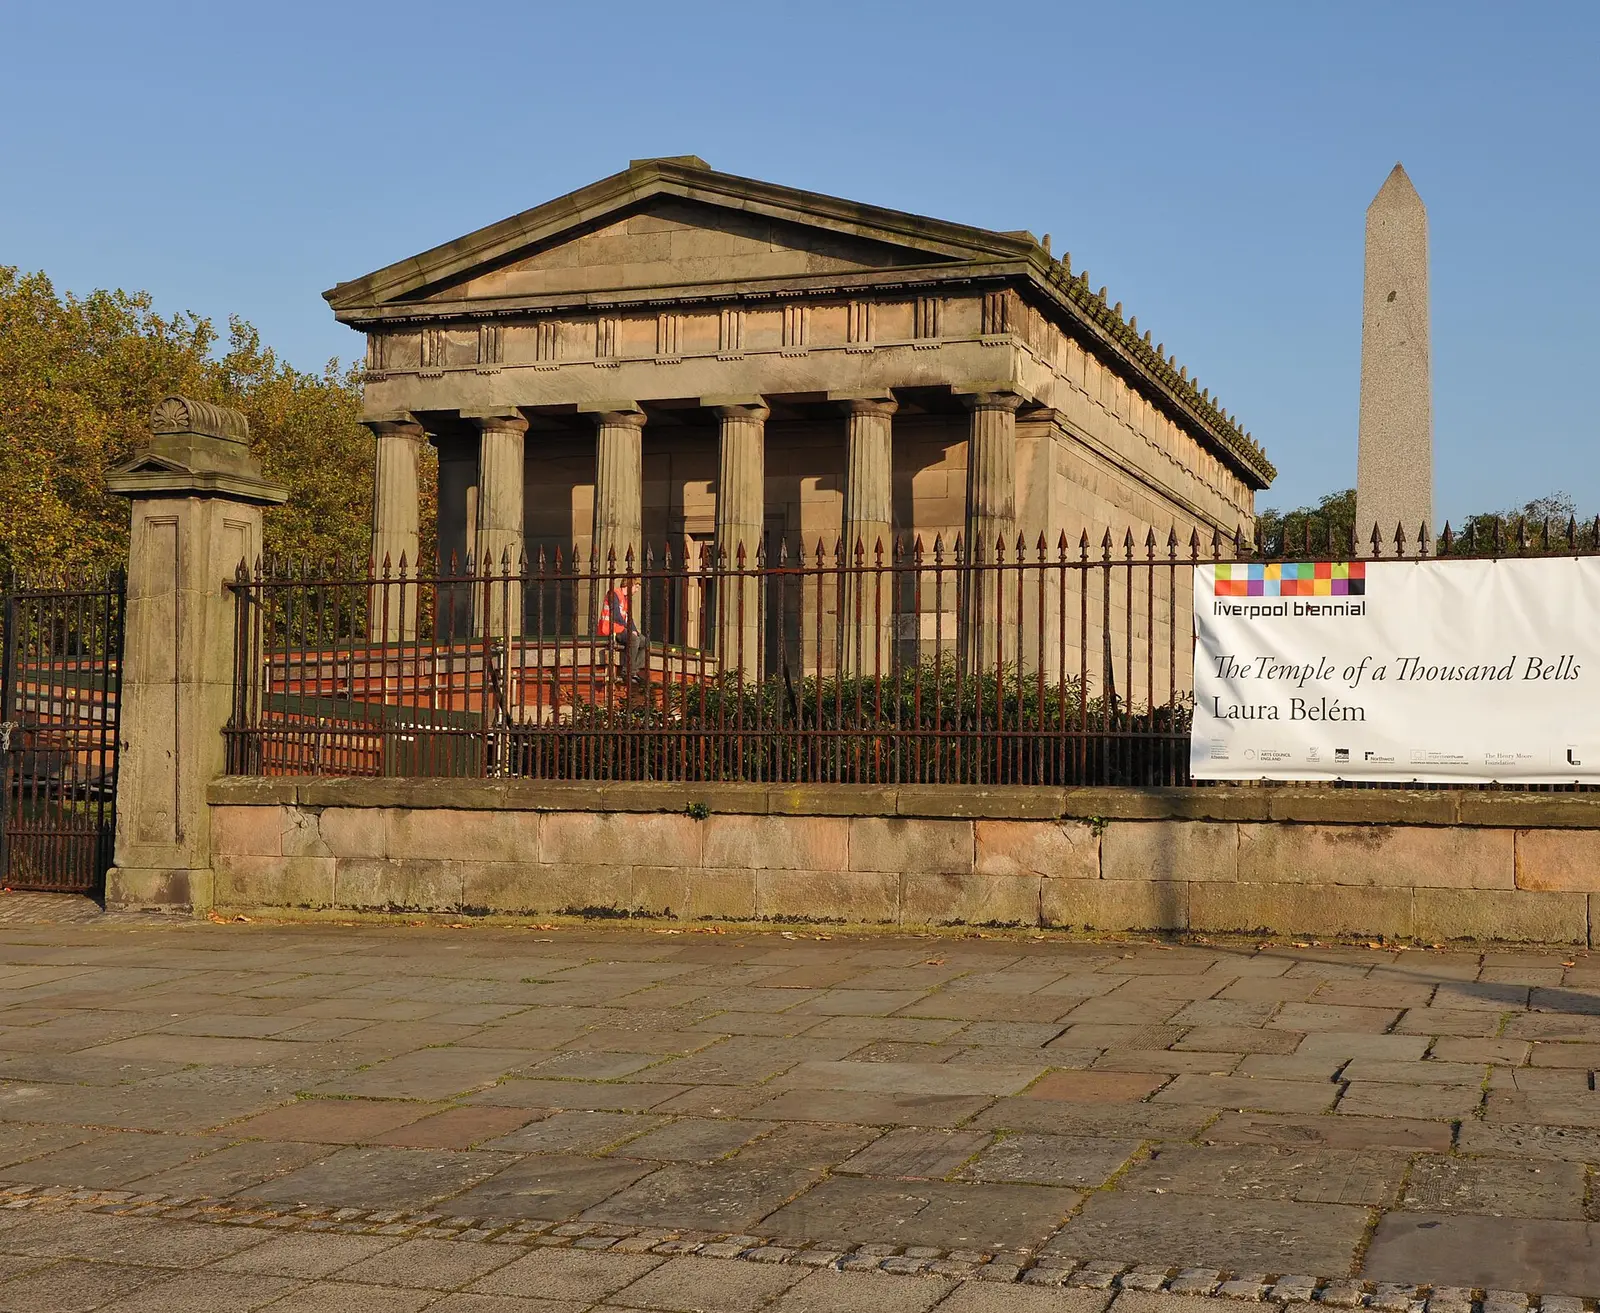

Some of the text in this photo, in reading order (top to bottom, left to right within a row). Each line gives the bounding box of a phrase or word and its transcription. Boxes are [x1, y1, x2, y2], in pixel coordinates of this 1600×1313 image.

[1214, 601, 1366, 619] liverpool biennial
[1214, 655, 1581, 688] The Temple of a Thousand Bells
[1213, 696, 1366, 722] Laura Belém
[1497, 752, 1514, 760] Henry
